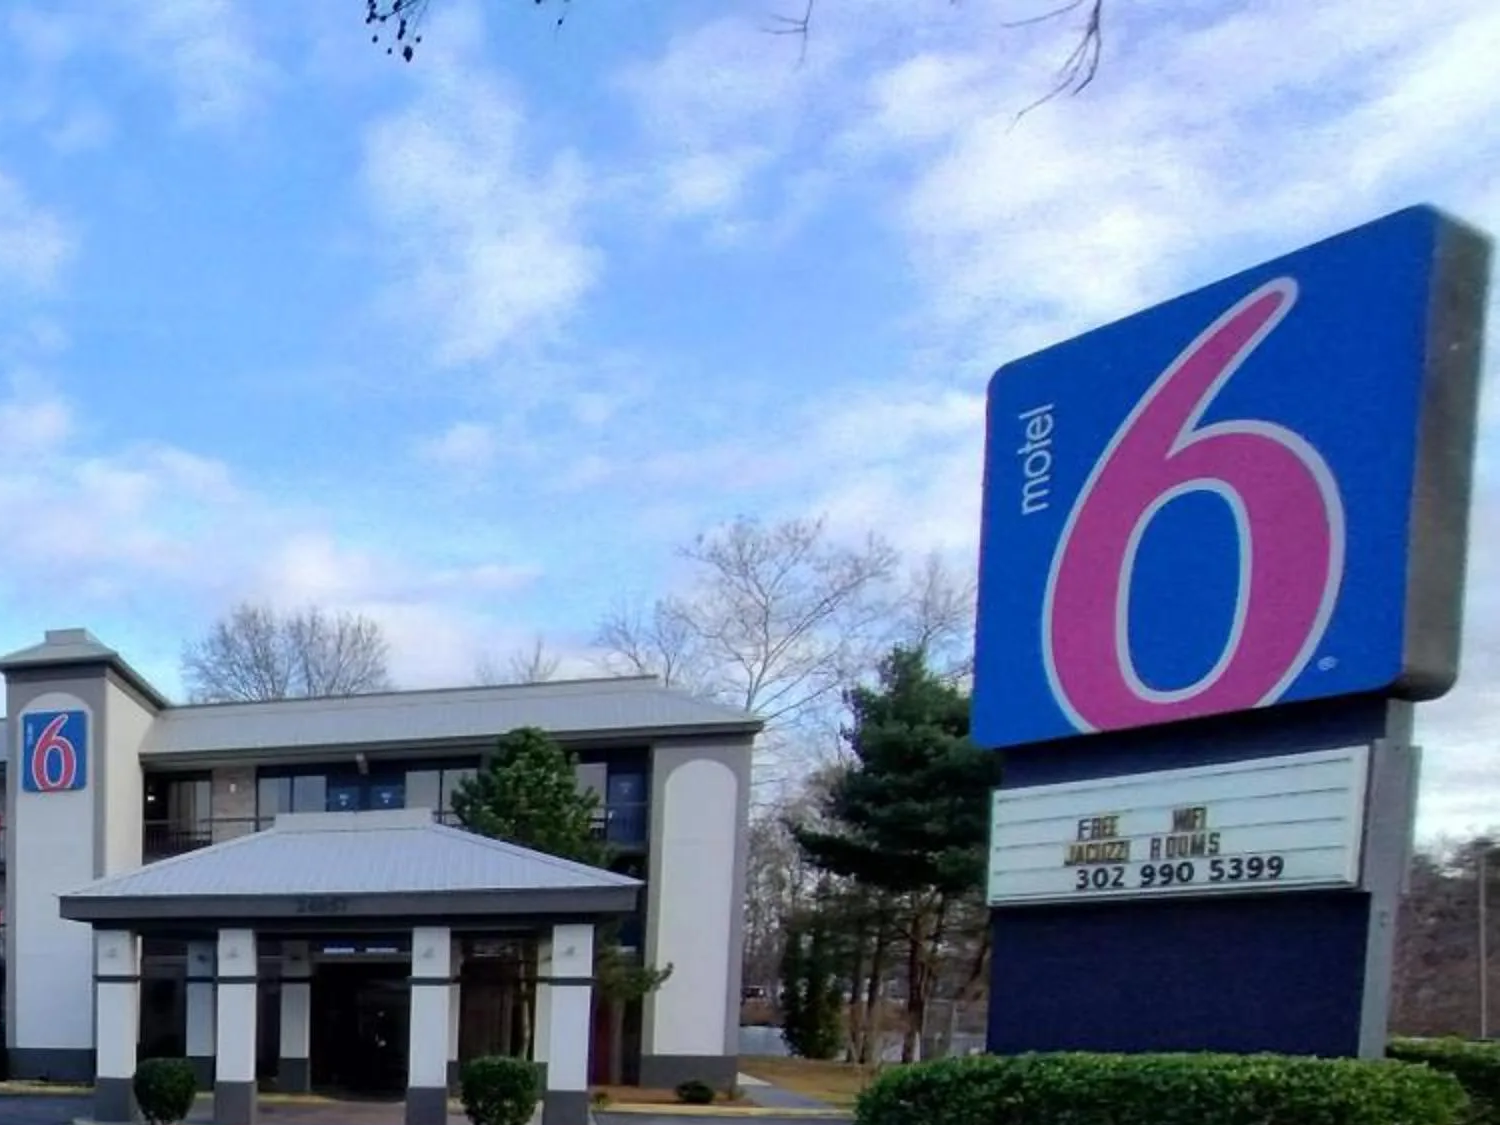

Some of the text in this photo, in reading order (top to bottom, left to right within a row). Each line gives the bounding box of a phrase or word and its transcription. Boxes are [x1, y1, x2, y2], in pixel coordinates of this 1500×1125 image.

[1019, 402, 1056, 517] motel
[1041, 276, 1347, 735] 6
[31, 713, 78, 792] 6
[1077, 806, 1207, 841] FREE WIFI
[1149, 832, 1221, 861] ROOMS
[1075, 855, 1285, 891] 302 990 5399
